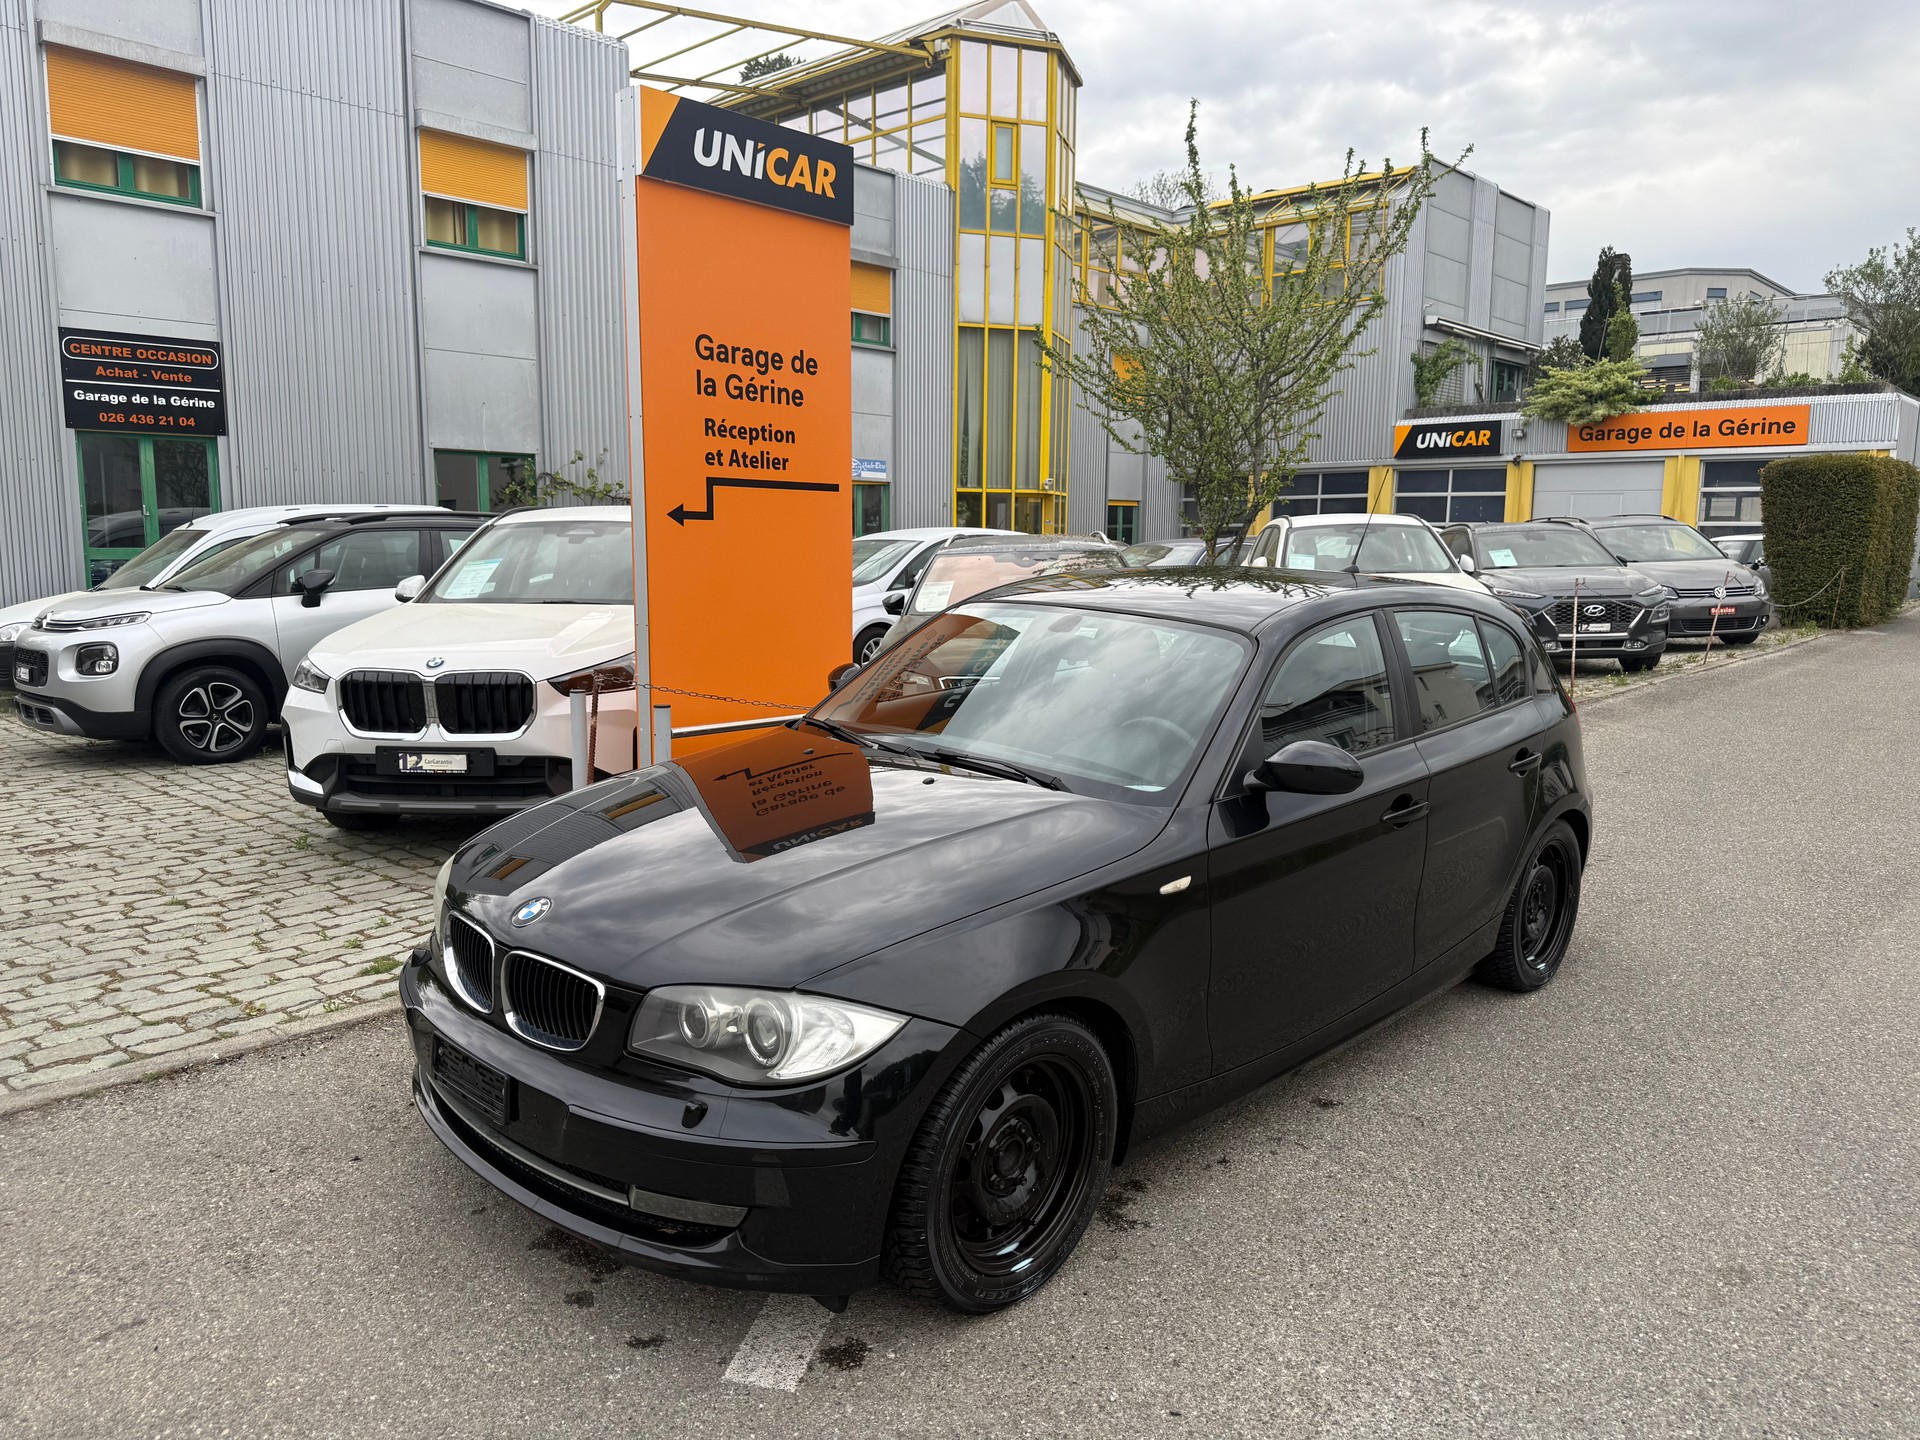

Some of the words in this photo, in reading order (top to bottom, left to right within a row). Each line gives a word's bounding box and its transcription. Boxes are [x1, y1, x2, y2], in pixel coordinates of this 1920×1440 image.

[69, 342, 132, 358] CENTRE
[137, 349, 212, 365] OCCASION
[695, 334, 784, 376] Garage
[791, 349, 818, 376] de
[95, 365, 139, 379] Achat
[151, 370, 193, 383] Vente
[73, 389, 128, 405] Garage
[132, 393, 149, 404] de
[153, 394, 166, 406] la
[170, 395, 216, 408] Gérine
[696, 369, 717, 397] la
[725, 373, 804, 407] Gérine
[99, 412, 125, 423] 026
[129, 414, 155, 425] 436
[158, 415, 174, 425] 21
[179, 416, 195, 427] 04
[1578, 425, 1653, 444] Garage
[1659, 422, 1685, 438] de
[1692, 420, 1711, 438] la
[1718, 417, 1796, 437] Gérine
[704, 418, 796, 446] Réception
[704, 449, 724, 467] et
[728, 449, 789, 471] Atelier
